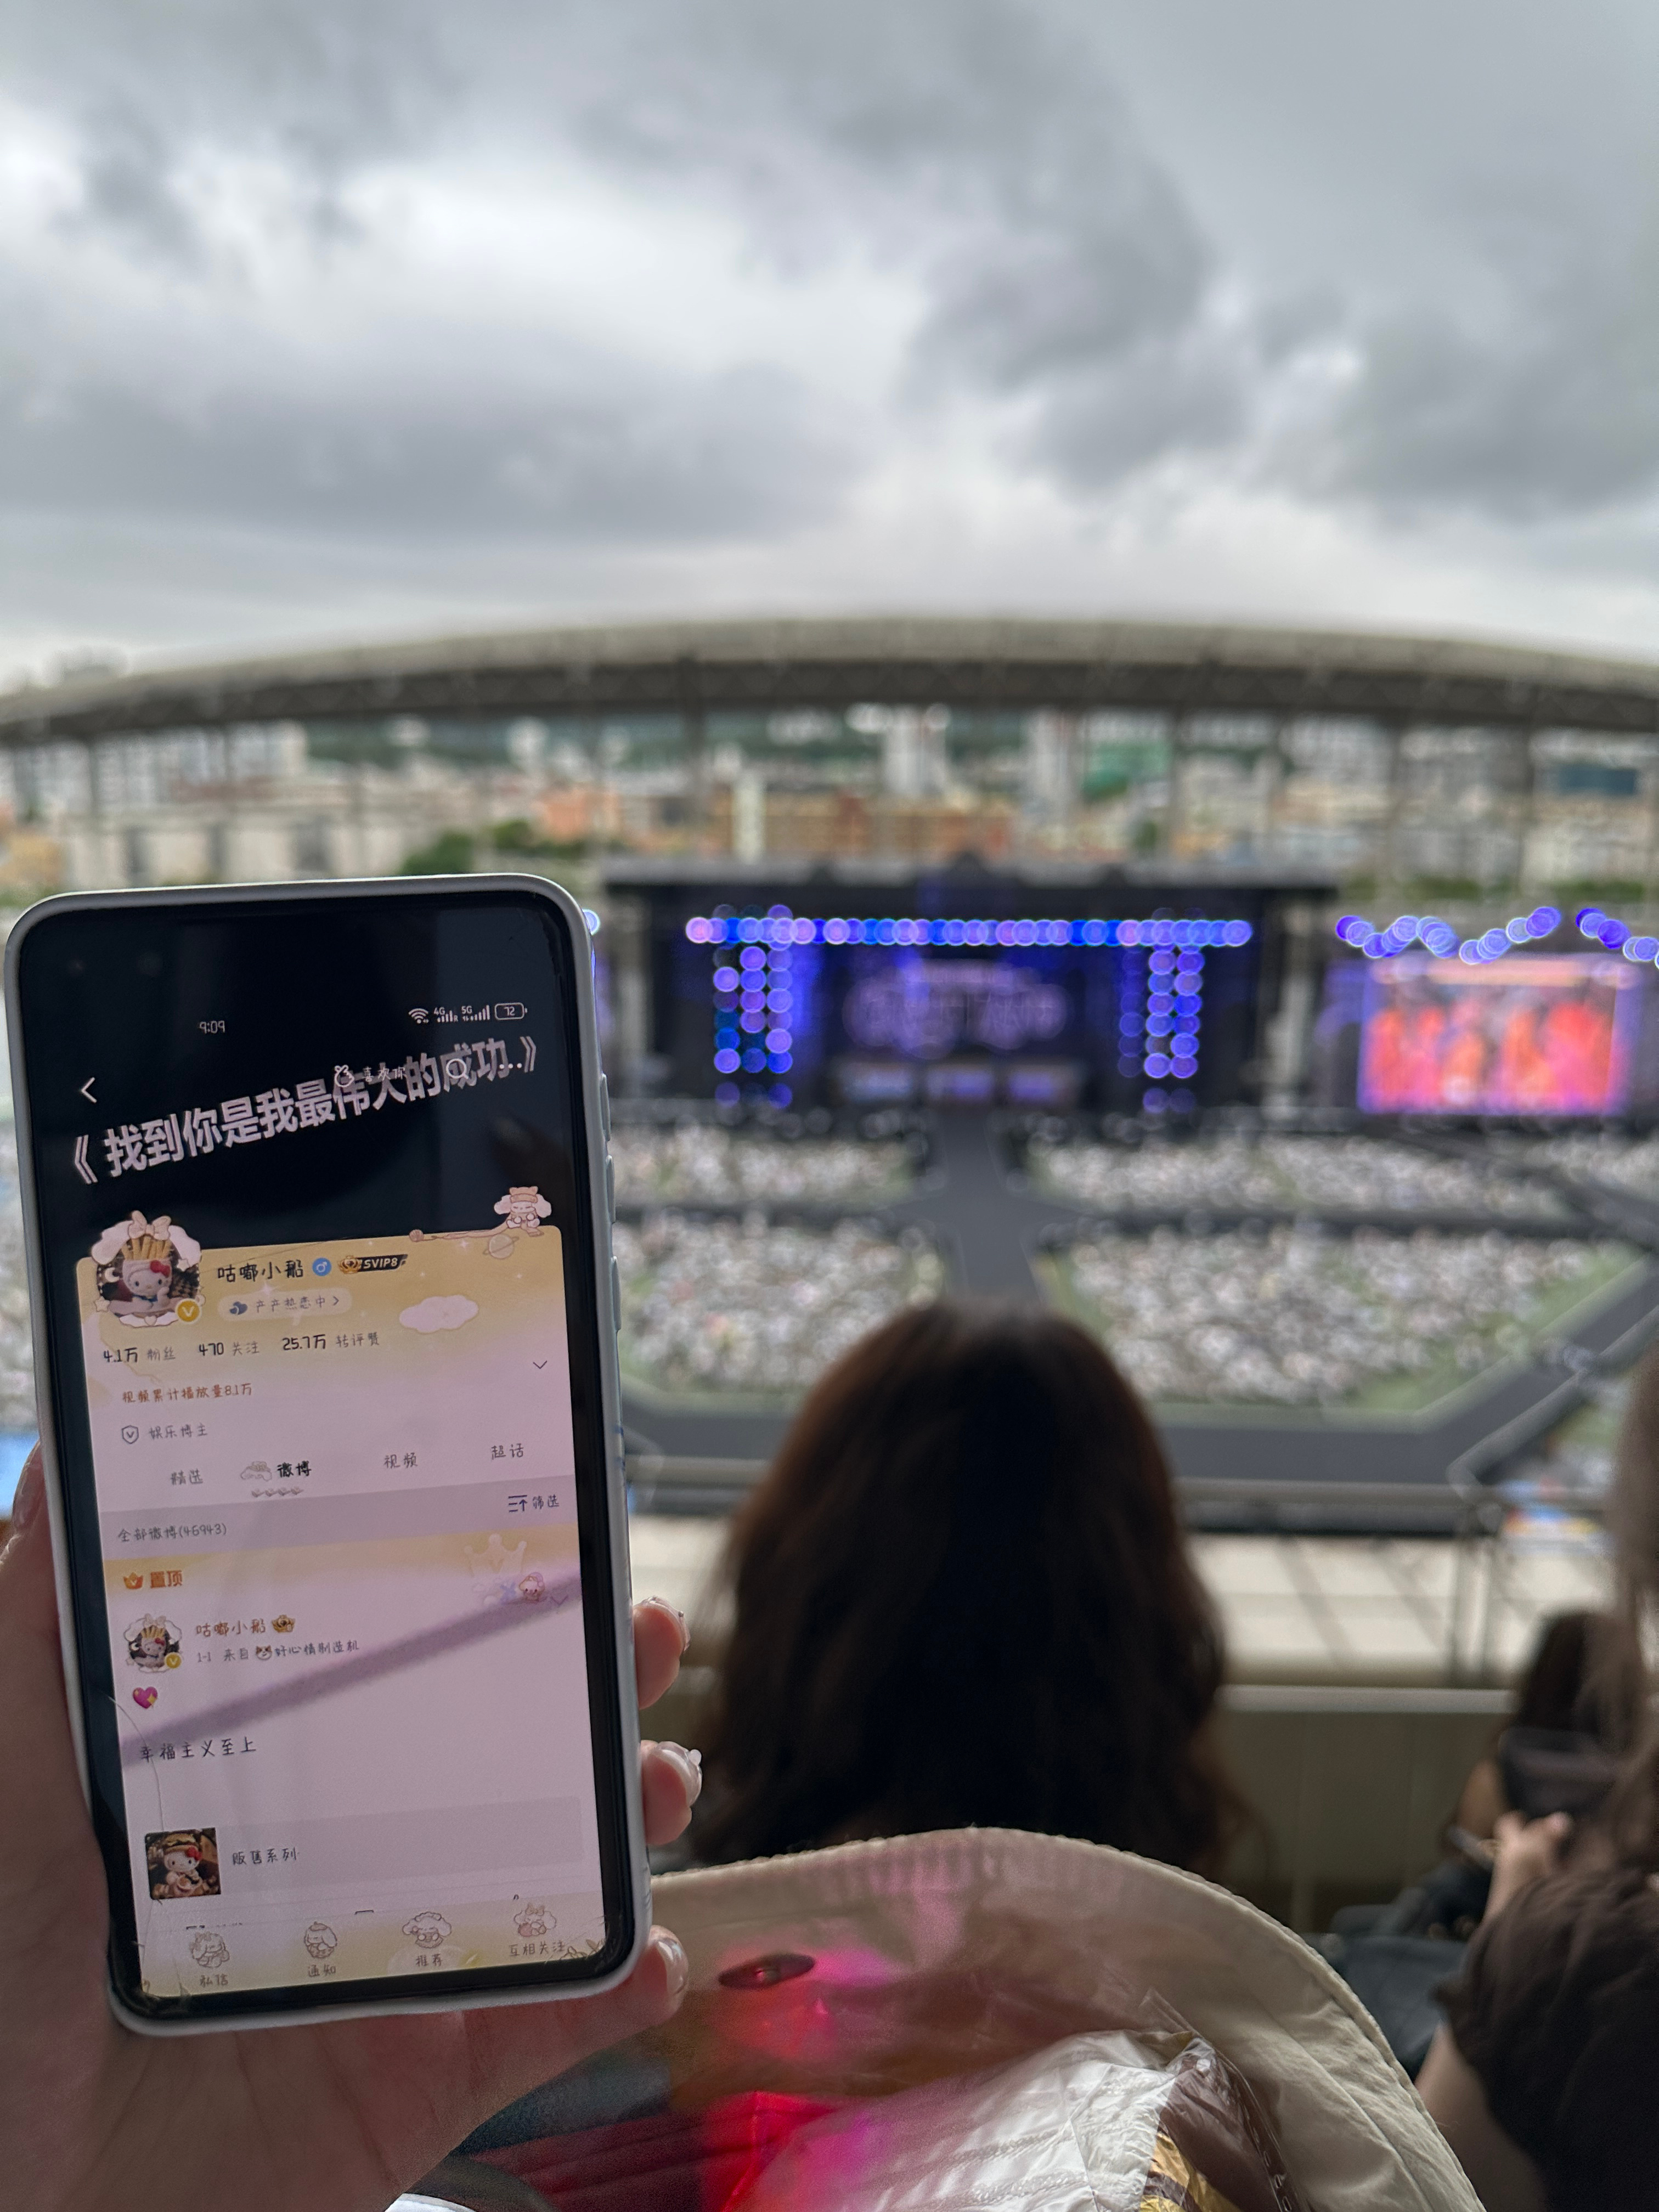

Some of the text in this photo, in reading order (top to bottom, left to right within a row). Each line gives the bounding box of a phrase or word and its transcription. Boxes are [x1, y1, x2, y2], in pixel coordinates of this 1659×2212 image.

[433, 1007, 445, 1015] 4G
[461, 1005, 472, 1014] 5G
[504, 1006, 515, 1015] 72
[199, 1020, 225, 1034] 9:09
[217, 1259, 304, 1283] 咕嘟小船
[363, 1257, 398, 1269] SVIP8
[103, 1332, 380, 1363] 4.1万 粉丝 470 关注 25.7万 转评赞
[149, 1423, 208, 1440] 娱乐博主
[490, 1443, 524, 1460] 超话
[276, 1460, 312, 1478] 微博
[383, 1452, 419, 1469] 视频
[170, 1468, 204, 1486] 精选
[532, 1494, 560, 1510] 筛选
[150, 1570, 183, 1589] 置顶
[196, 1618, 267, 1638] 咕嘟小船
[223, 1647, 249, 1662] 来自
[140, 1736, 257, 1763] 幸福主义至上
[509, 1939, 566, 1956] 互相关注
[416, 1953, 443, 1967] 推荐
[308, 1964, 336, 1978] 通知
[199, 1973, 229, 1988] 私信
